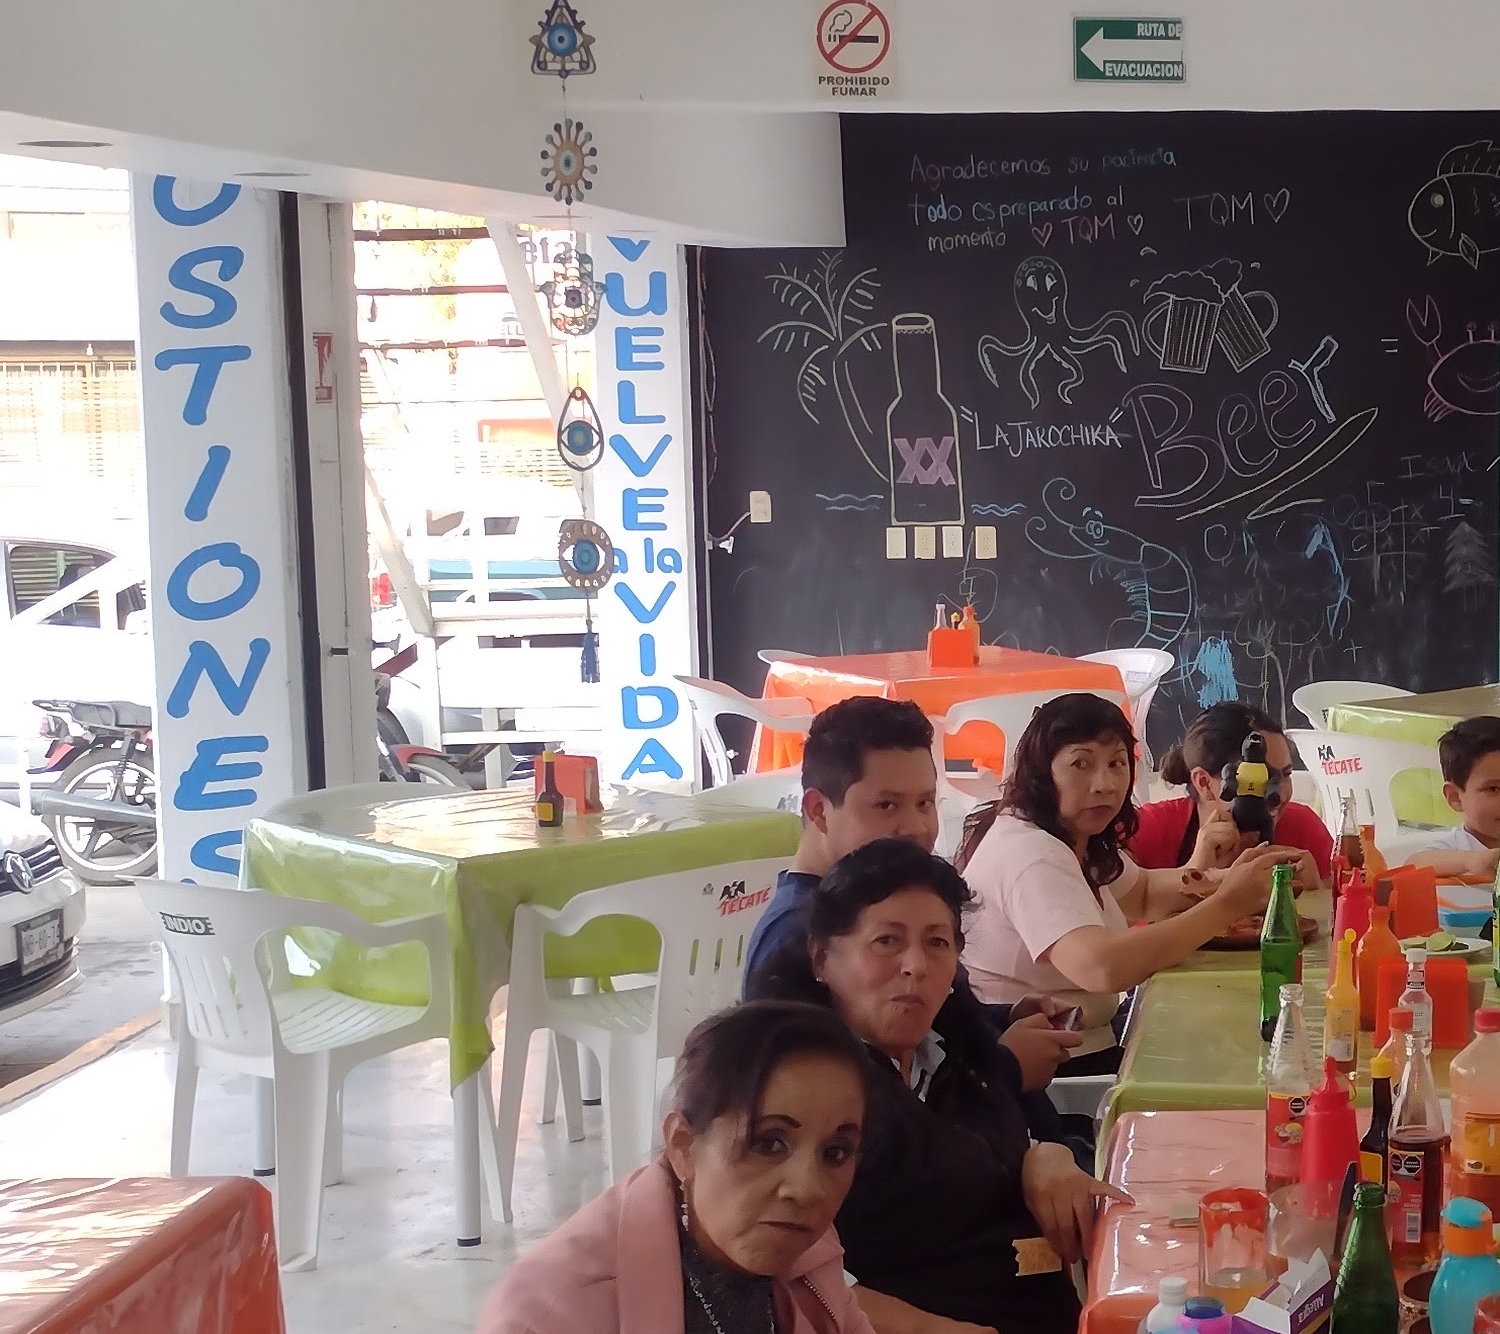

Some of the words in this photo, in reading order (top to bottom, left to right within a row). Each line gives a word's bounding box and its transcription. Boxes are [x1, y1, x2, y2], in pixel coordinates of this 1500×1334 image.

[1136, 22, 1165, 38] RUTA
[1168, 22, 1182, 38] DE
[818, 75, 890, 86] PROHIBIDO
[1105, 63, 1182, 78] EVACUACION
[831, 87, 877, 97] FUMAR
[910, 153, 1052, 191] Agradecemos
[908, 192, 963, 227] todo
[1105, 184, 1126, 206] al
[1173, 191, 1255, 231] TQM
[927, 225, 1007, 253] momento
[1060, 212, 1116, 244] TQM
[1122, 335, 1339, 509] Beer
[894, 435, 957, 487] XX
[643, 536, 683, 574] la
[613, 580, 684, 781] VIDA
[1321, 757, 1363, 776] TECATE
[718, 885, 772, 917] TECATE
[164, 915, 206, 934] INDIO
